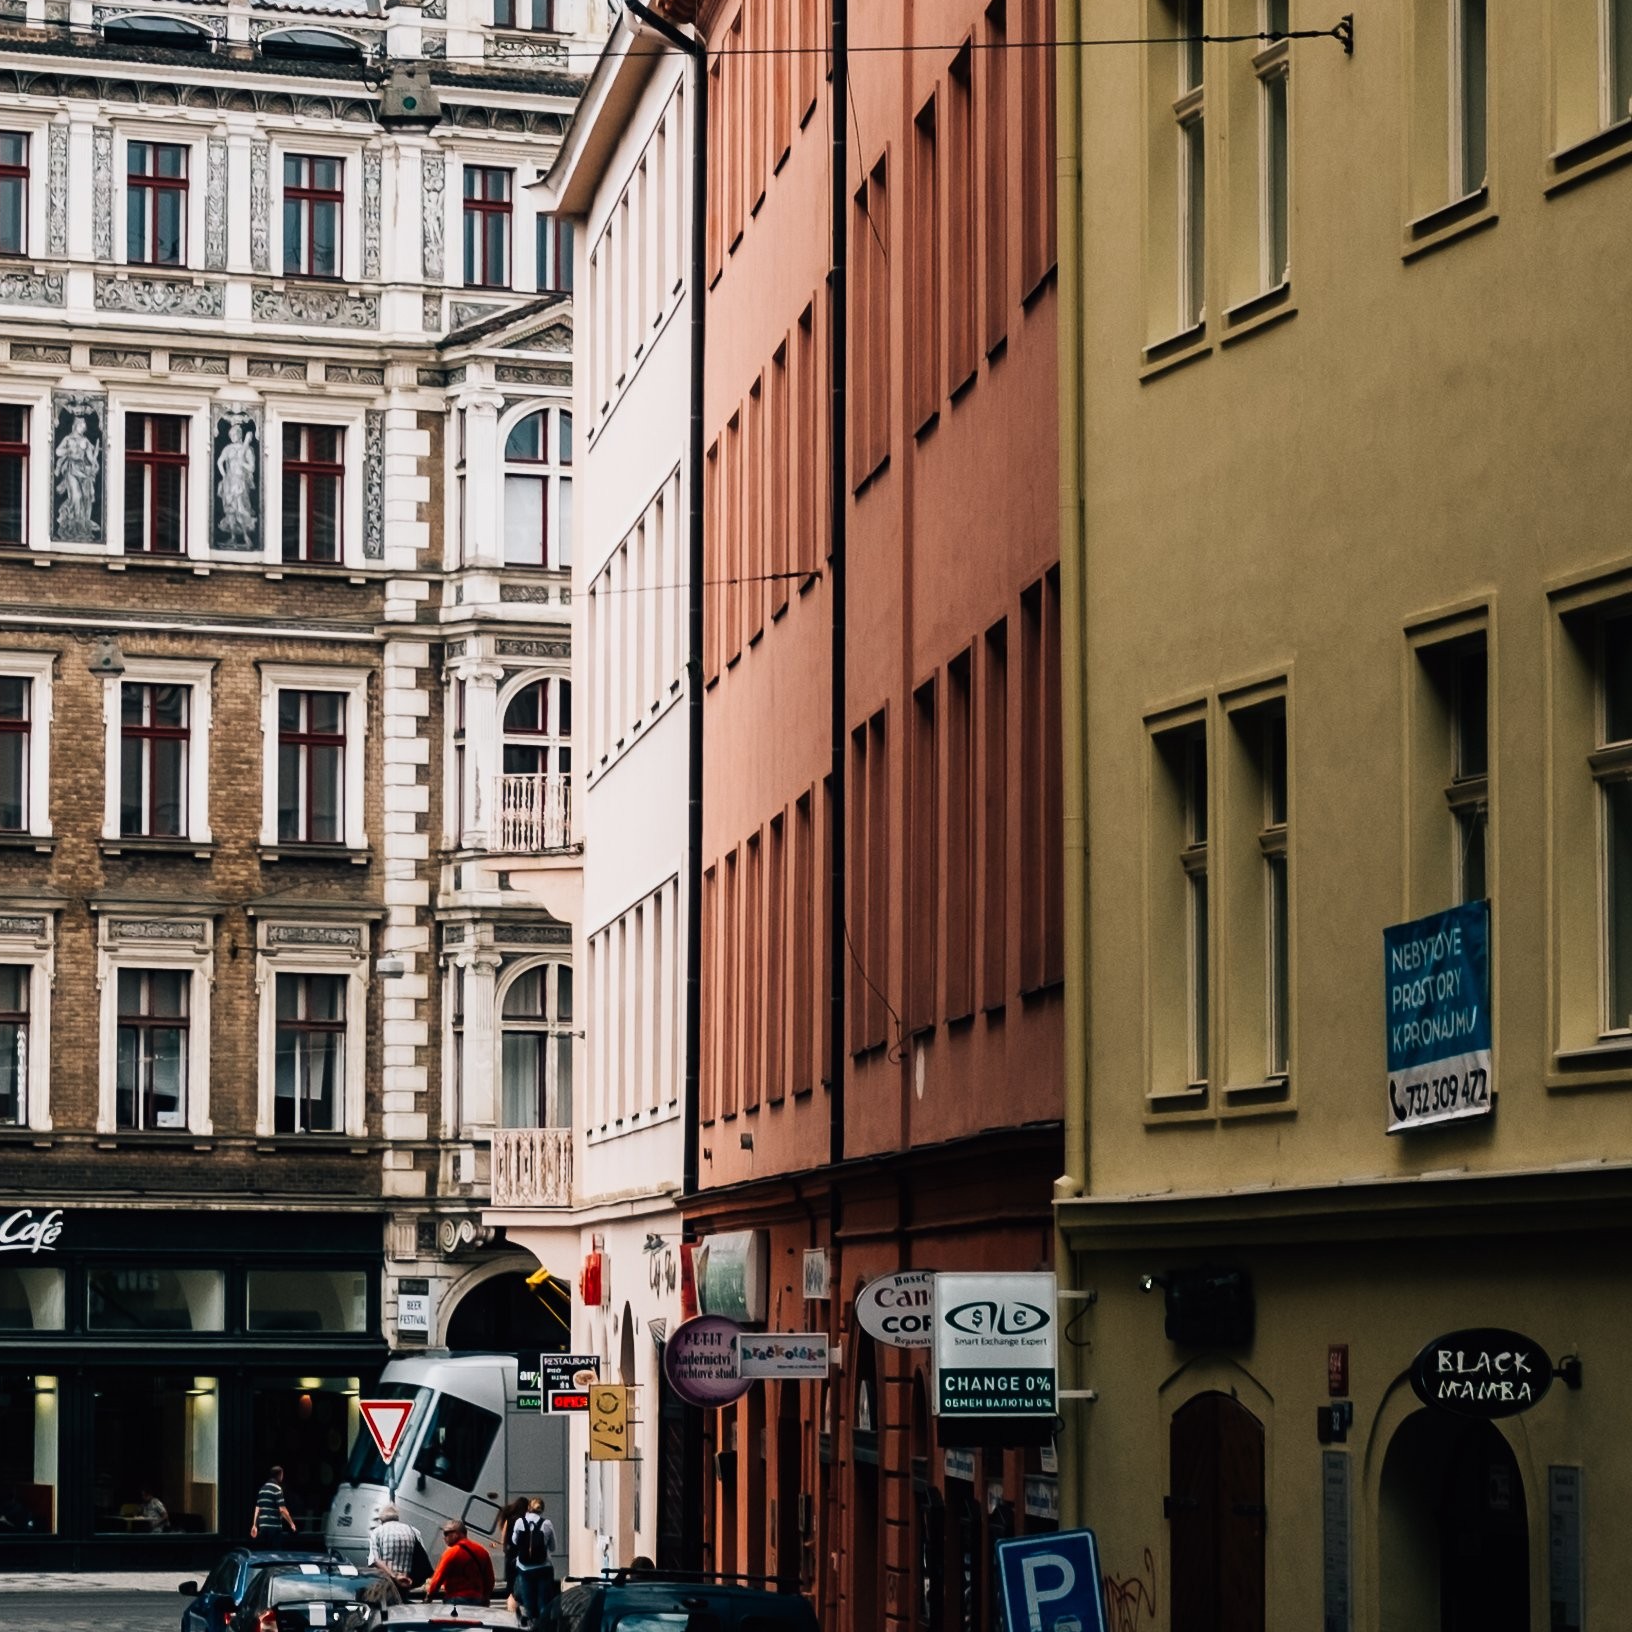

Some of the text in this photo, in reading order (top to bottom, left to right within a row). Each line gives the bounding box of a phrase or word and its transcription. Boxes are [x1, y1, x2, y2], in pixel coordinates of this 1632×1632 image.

[1393, 920, 1462, 974] NEBYTOVÉ
[1393, 968, 1462, 1013] PROSTORY
[1393, 1004, 1477, 1053] K PRONÁJMU
[1406, 1067, 1488, 1116] 732 309 472
[407, 1300, 422, 1310] BEER
[874, 1287, 932, 1308] Can
[400, 1314, 427, 1325] FESTIVAL
[955, 1337, 1048, 1347] Smart Exchange Expert
[543, 1357, 598, 1366] RESTAURANT
[675, 1350, 731, 1366] Kadeřnictví
[1436, 1349, 1532, 1375] BLACK
[945, 1376, 1051, 1391] CHANGE 0%
[1437, 1380, 1532, 1402] MAMBA
[945, 1399, 983, 1407] ОБМЕН
[986, 1399, 1034, 1407] ВАЛЮТЫ
[1021, 1554, 1076, 1632] P
